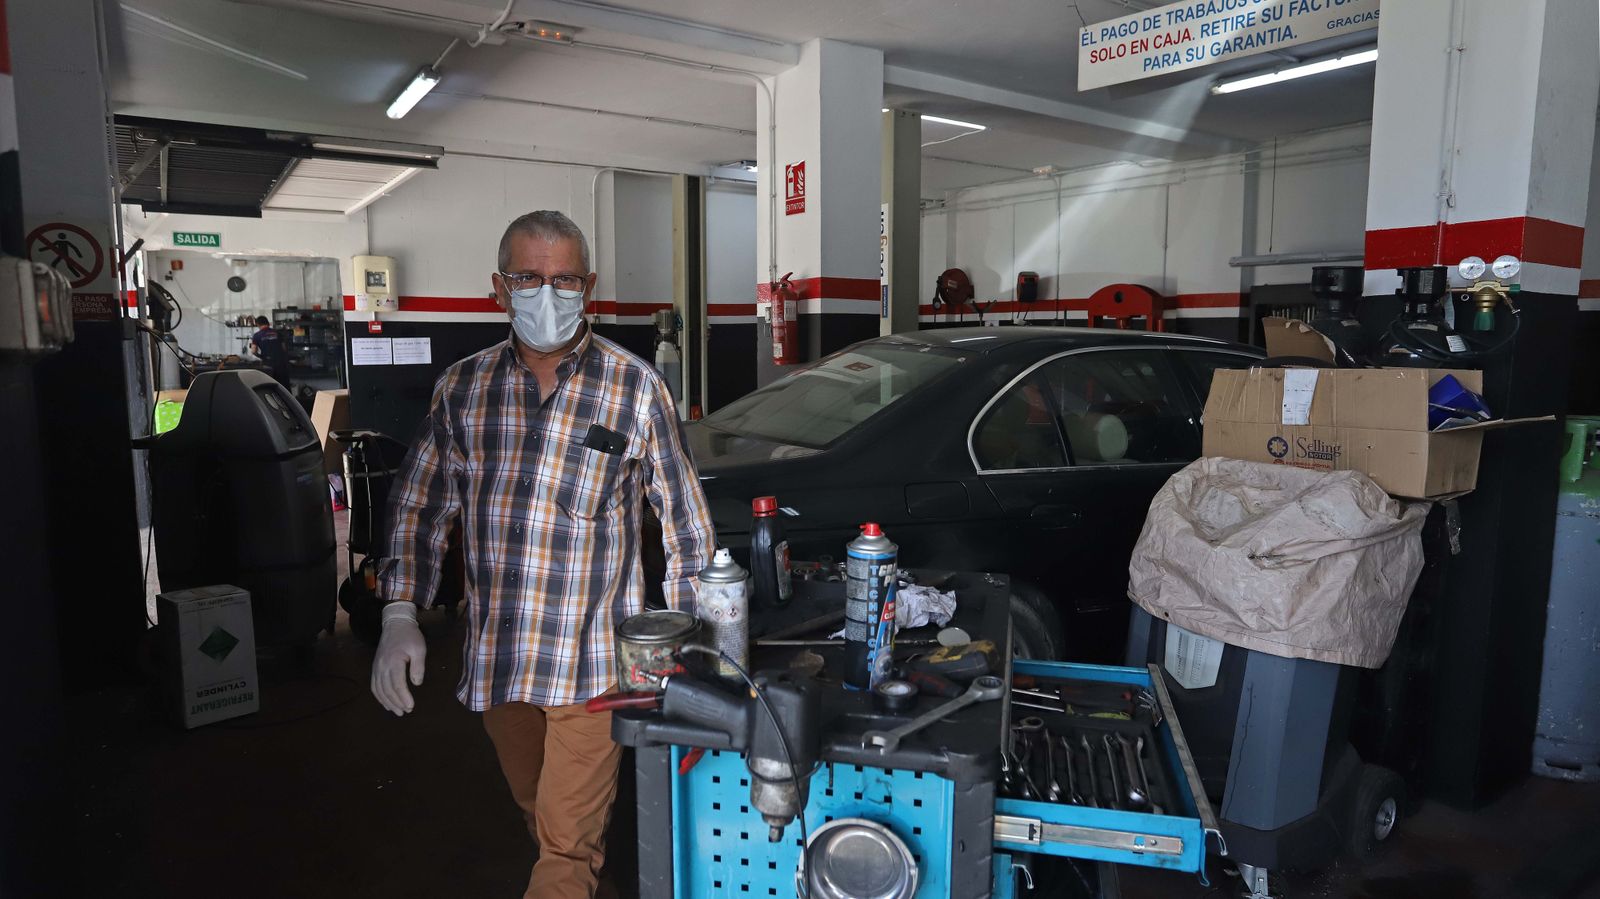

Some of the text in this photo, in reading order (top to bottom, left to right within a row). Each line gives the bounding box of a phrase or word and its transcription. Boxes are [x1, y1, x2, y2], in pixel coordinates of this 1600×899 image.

[1081, 31, 1097, 47] EL
[1101, 20, 1138, 42] PAGO
[1142, 14, 1161, 32] DE
[1327, 9, 1380, 30] GRACIAS
[1089, 43, 1126, 64] SOLO
[1130, 38, 1149, 55] EN
[1153, 28, 1195, 49] CAJA.
[1200, 11, 1256, 38] RETIRE
[1261, 4, 1283, 23] SU
[1143, 25, 1298, 72] PARA SU GARANTIA.
[176, 233, 216, 245] SALIDA
[1296, 436, 1342, 459] Selling
[196, 681, 247, 698] CYLINDER
[190, 692, 254, 715] REFRIGERANT
